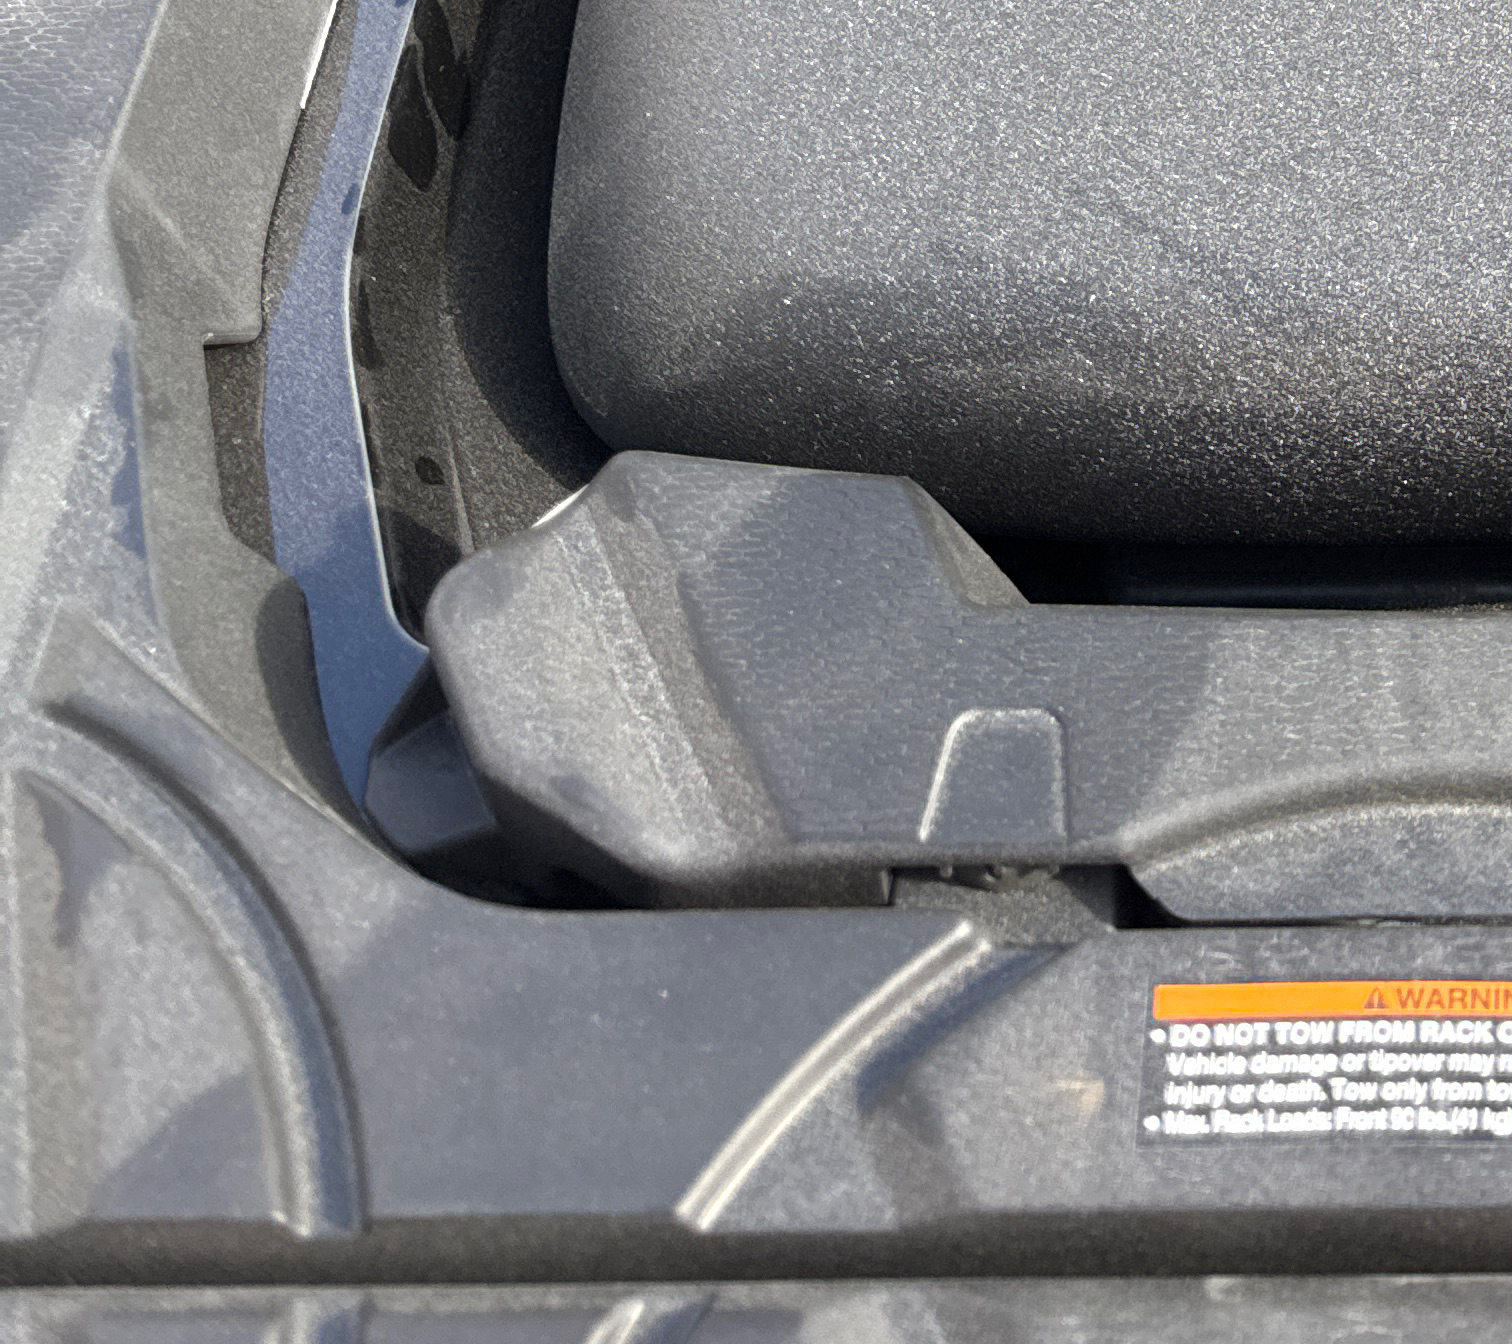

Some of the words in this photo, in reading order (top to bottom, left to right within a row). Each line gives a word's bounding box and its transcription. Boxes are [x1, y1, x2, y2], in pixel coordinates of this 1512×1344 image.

[1169, 1024, 1211, 1048] DO
[1213, 1023, 1272, 1049] NOT
[1273, 1022, 1334, 1045] TOW
[1338, 1021, 1415, 1044] FROM
[1420, 1021, 1493, 1045] RACK
[1165, 1052, 1246, 1077] Vehicle
[1248, 1051, 1338, 1077] damage
[1339, 1054, 1366, 1073] or
[1367, 1049, 1445, 1076] tipover
[1446, 1054, 1495, 1077] may
[1164, 1082, 1226, 1107] injury
[1227, 1085, 1254, 1106] or
[1256, 1079, 1327, 1105] death.
[1329, 1078, 1378, 1103] Tow
[1379, 1077, 1428, 1104] only
[1429, 1078, 1483, 1105] from
